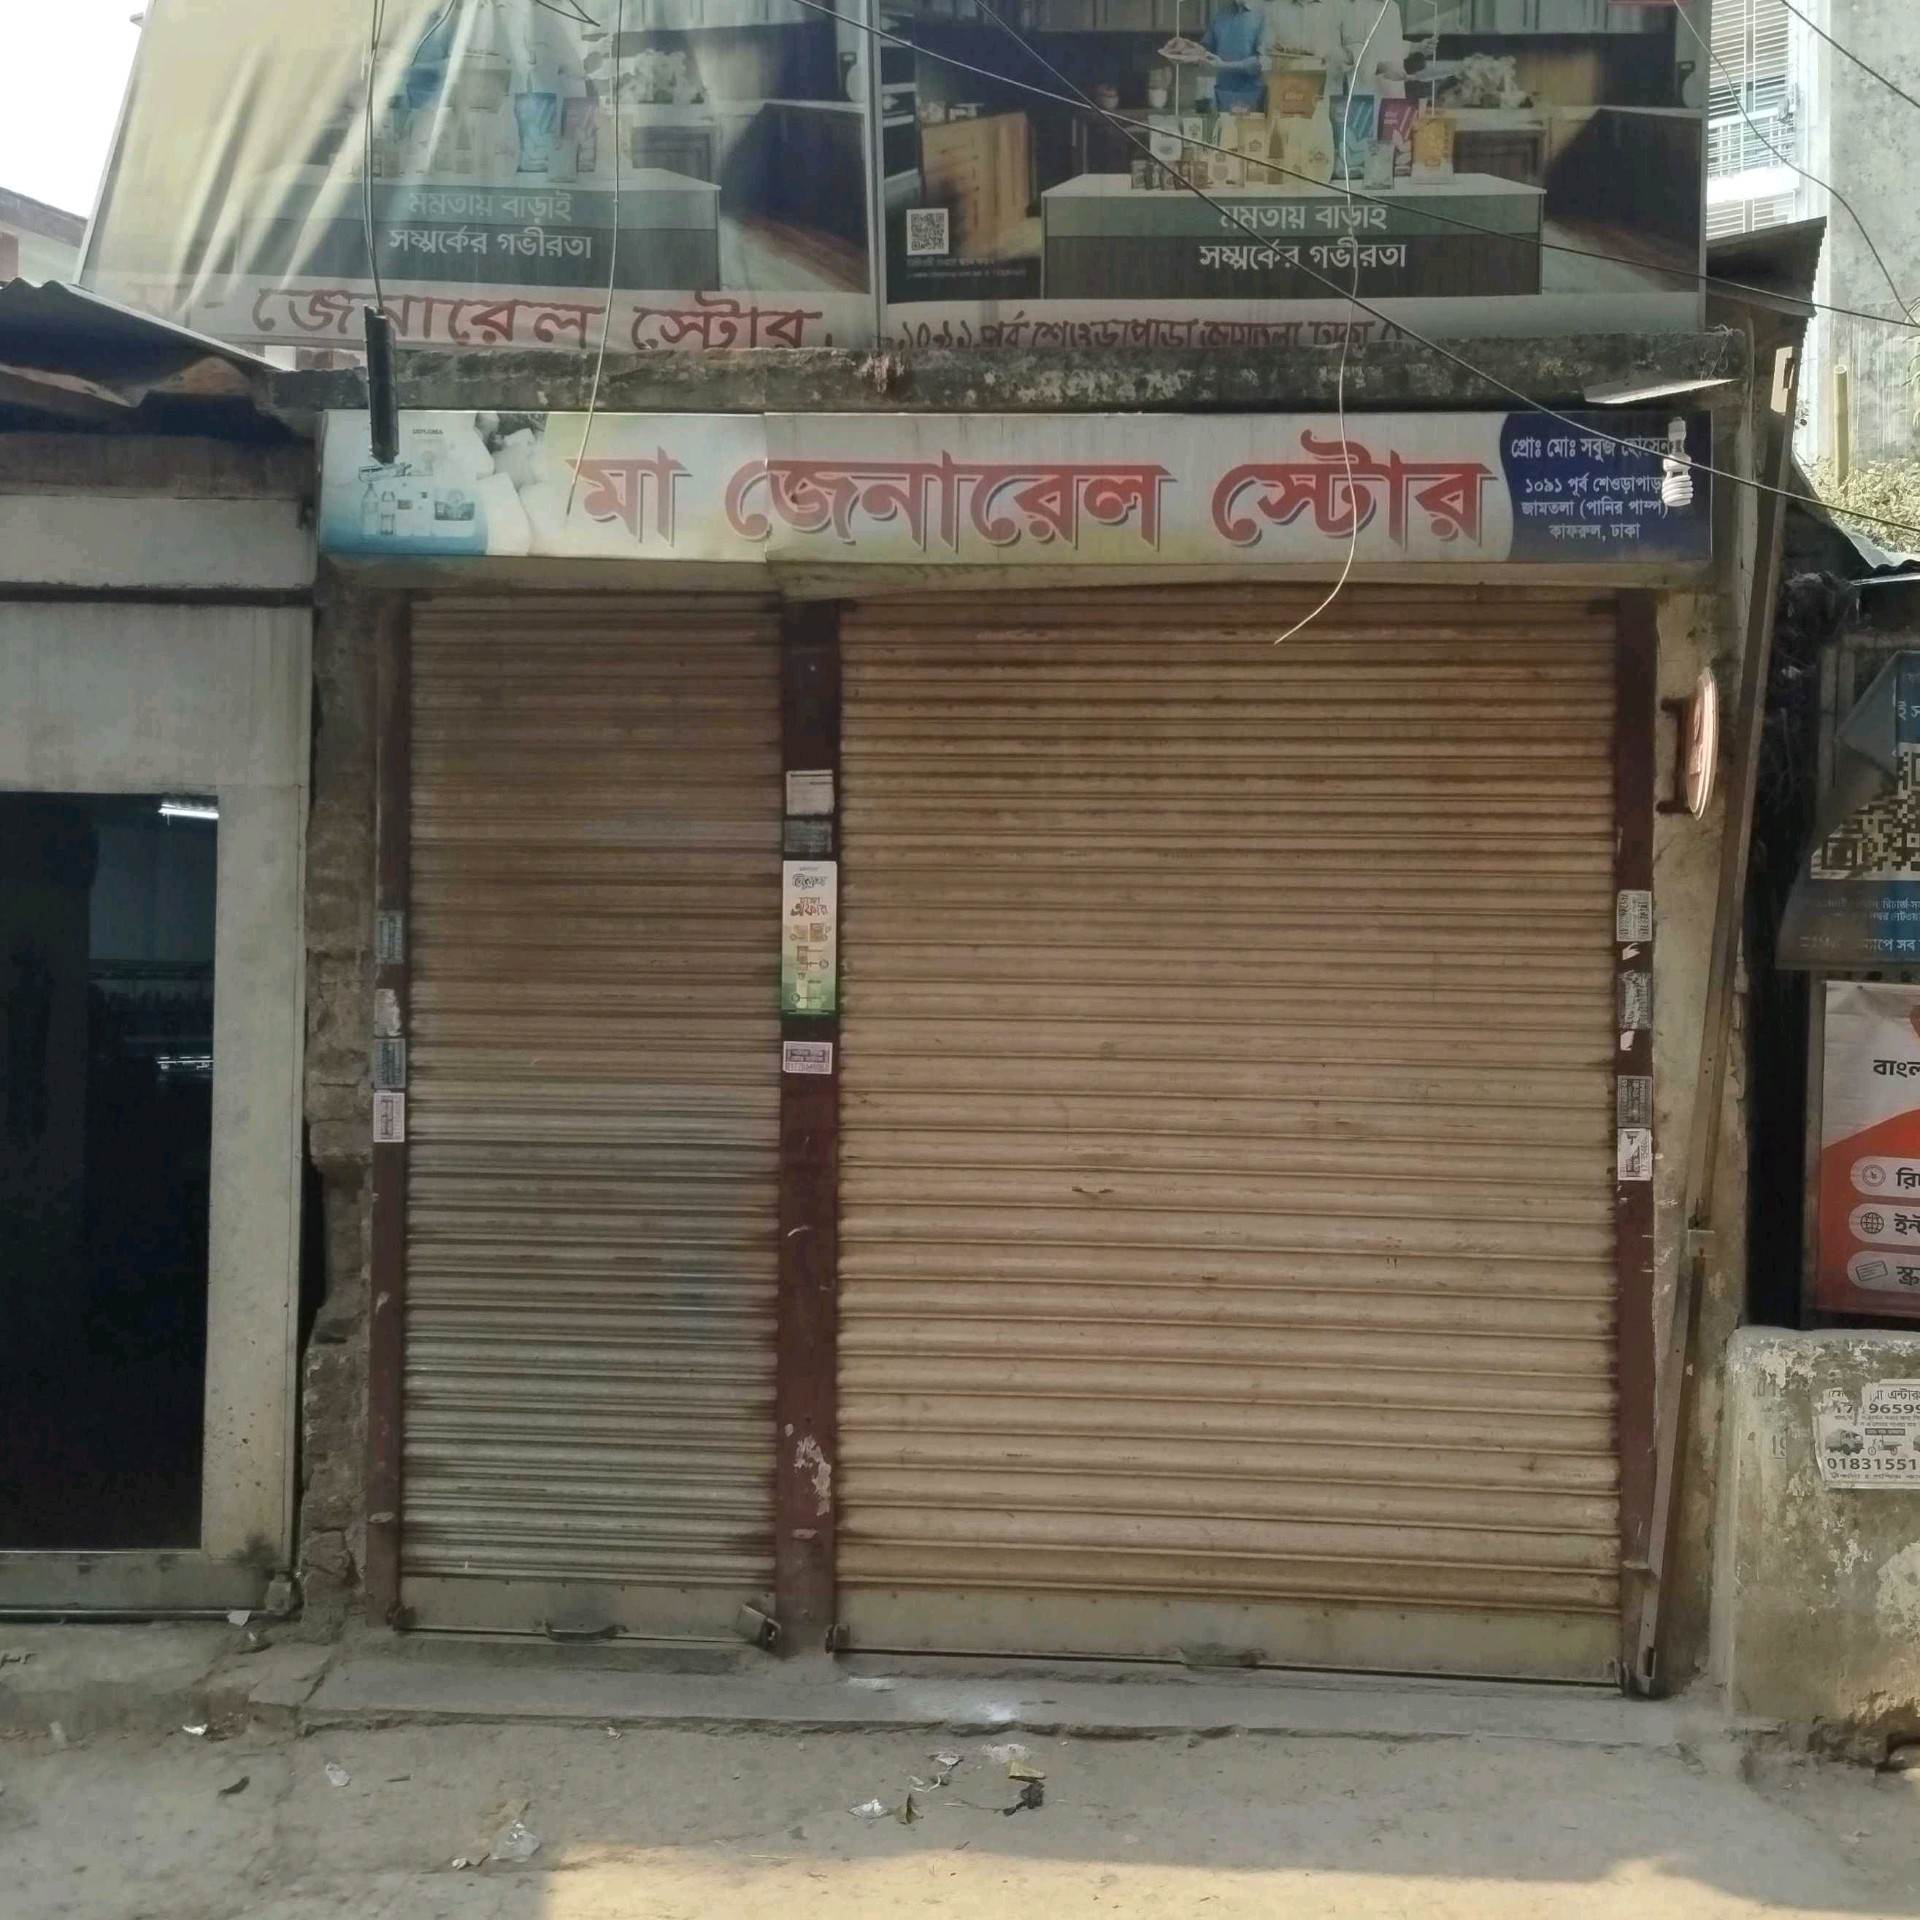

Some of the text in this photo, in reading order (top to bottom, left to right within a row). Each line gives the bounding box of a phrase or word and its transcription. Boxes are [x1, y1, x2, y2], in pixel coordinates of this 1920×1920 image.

[503, 189, 573, 223] বাড়াই
[389, 225, 593, 259] সম্পর্কের গভীরতা
[1310, 237, 1409, 269] গভীরতা
[1580, 436, 1616, 463] সবুজ
[564, 429, 1502, 553] মা জেনারেল স্টোর
[1525, 473, 1664, 497] ১০৯১ পূর্ব শেওড়াপাড়
[1521, 500, 1574, 517] জামতলা
[1610, 523, 1641, 540] ঢাকা
